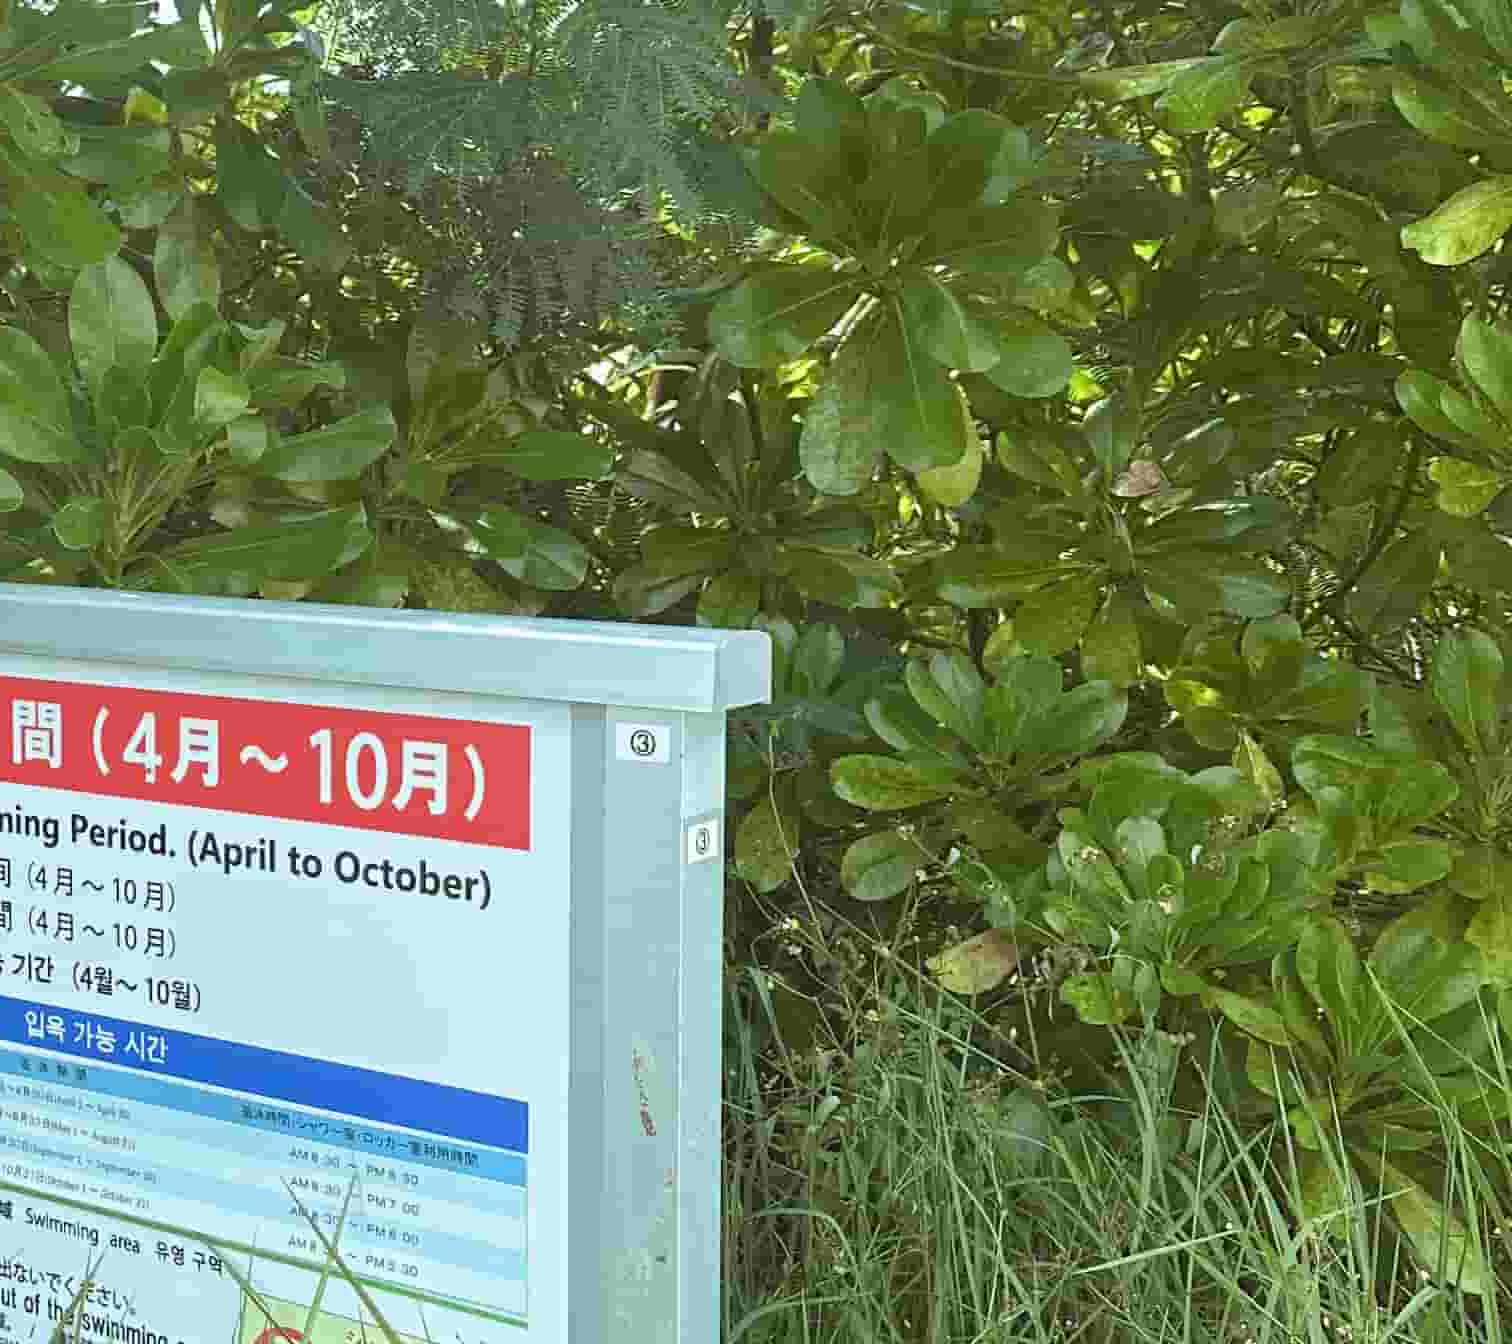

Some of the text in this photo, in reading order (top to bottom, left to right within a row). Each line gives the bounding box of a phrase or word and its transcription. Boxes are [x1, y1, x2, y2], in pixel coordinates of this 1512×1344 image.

[71, 812, 175, 859] Period.
[188, 828, 275, 878] (April
[289, 846, 321, 880] to
[334, 849, 491, 911] October)
[12, 949, 54, 985] 기간
[74, 1019, 116, 1055] 가능
[126, 1030, 167, 1066] 시간
[24, 1206, 140, 1255] Swimming area
[24, 1291, 39, 1316] of
